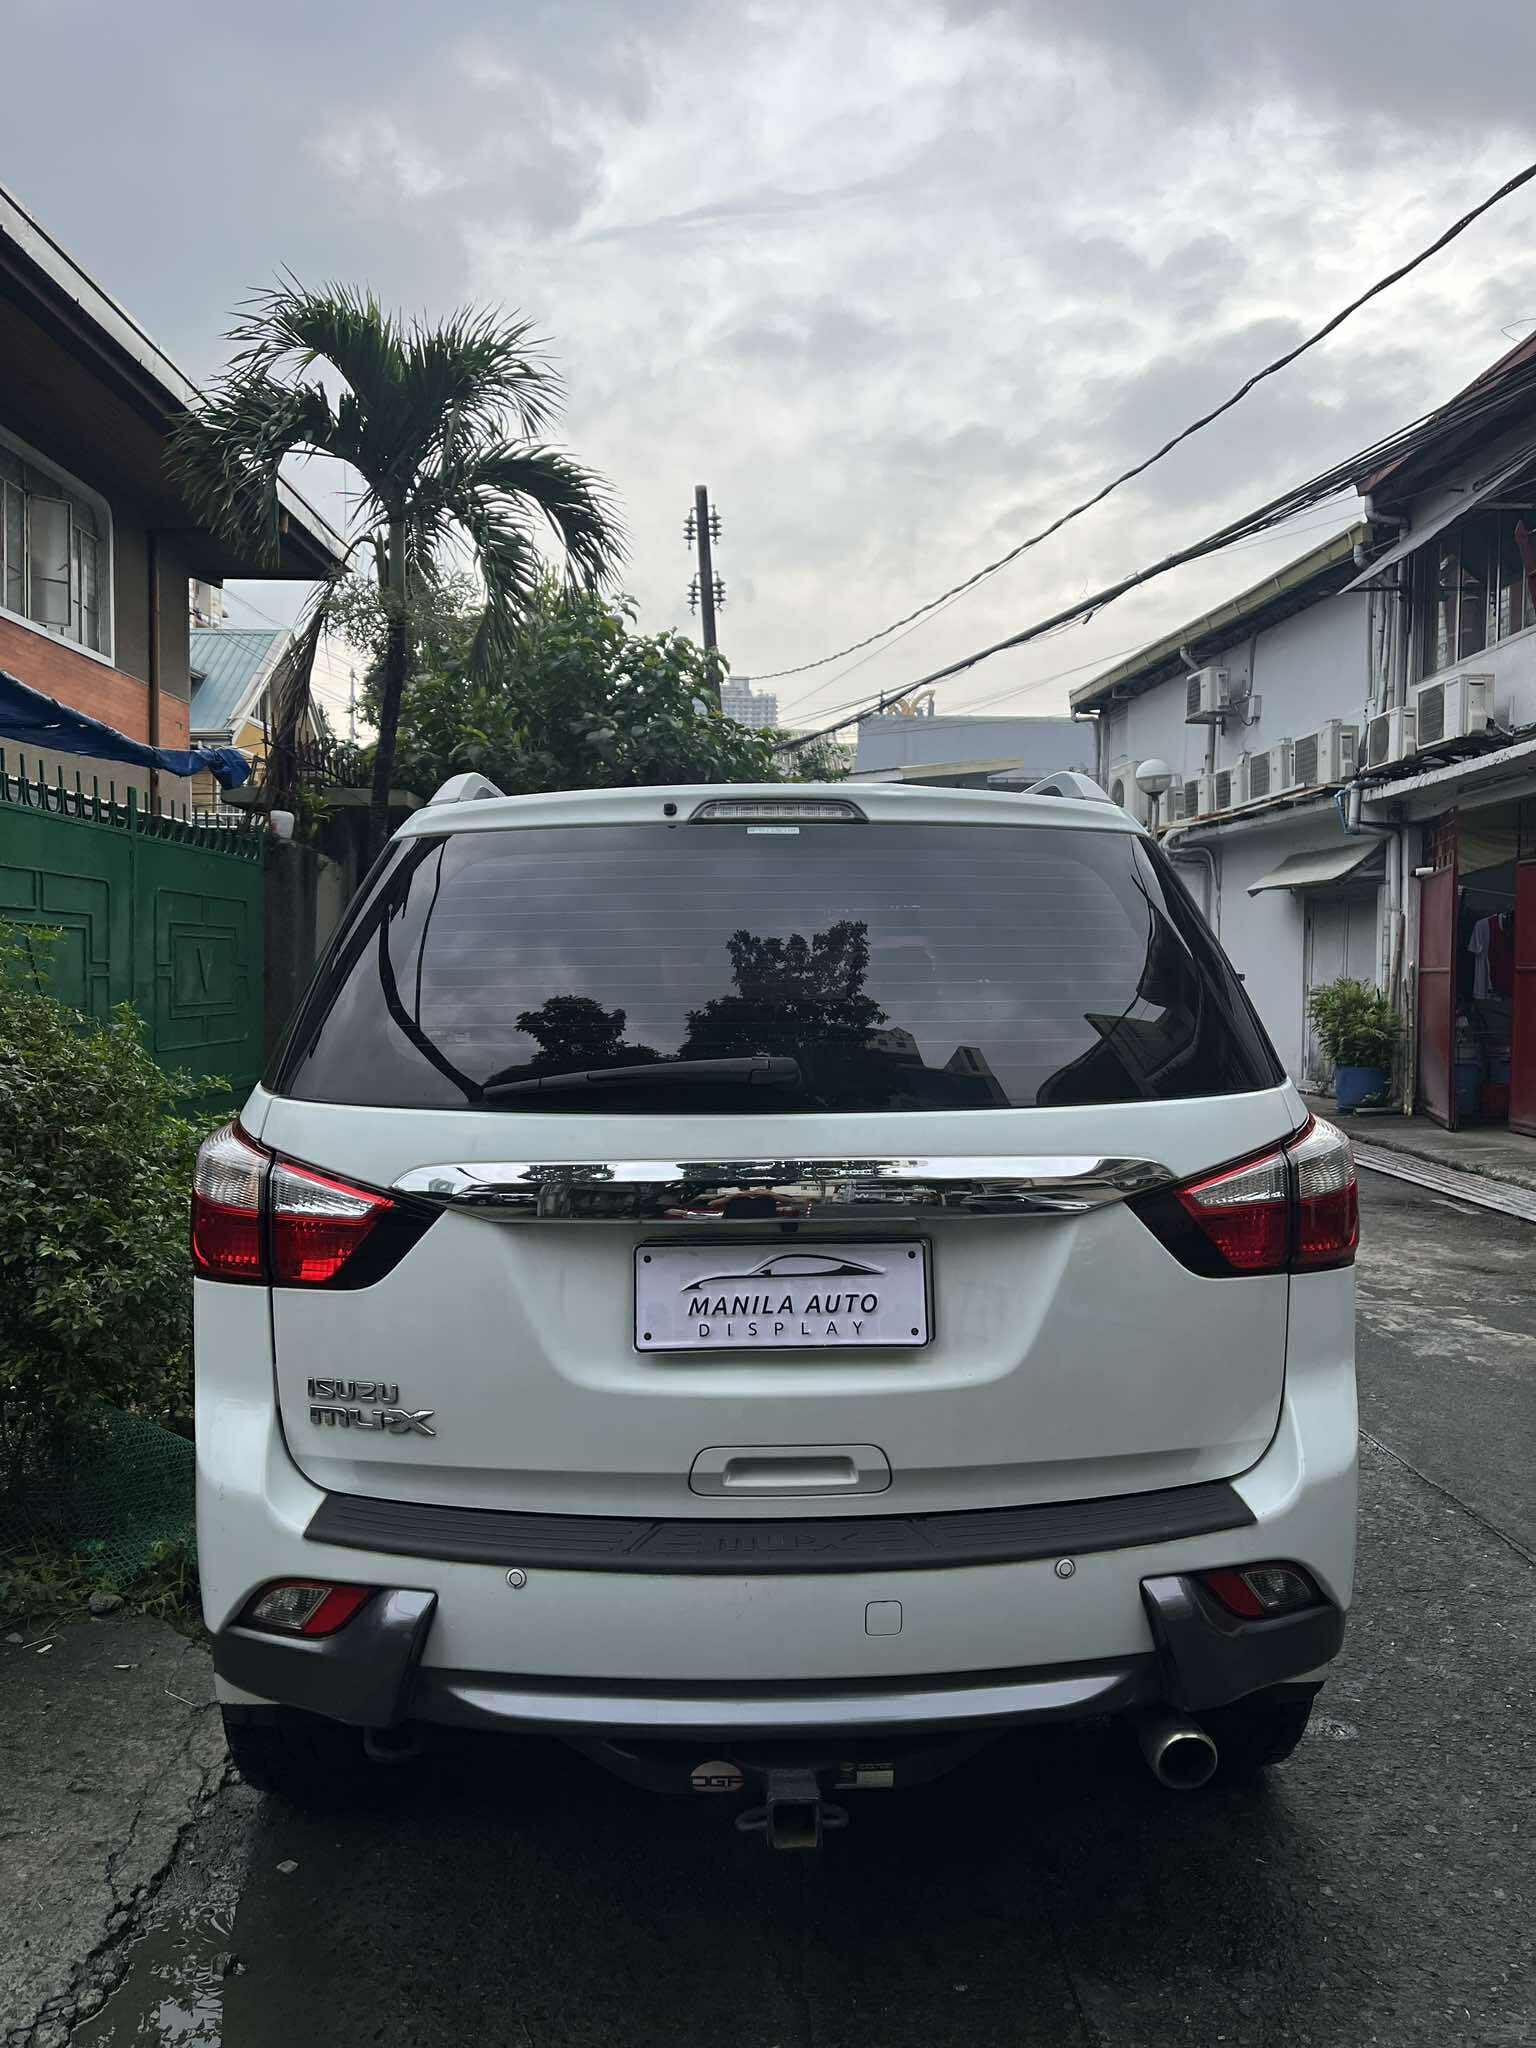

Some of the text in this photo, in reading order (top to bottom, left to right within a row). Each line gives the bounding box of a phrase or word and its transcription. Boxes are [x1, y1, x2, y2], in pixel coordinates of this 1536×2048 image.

[688, 1293, 879, 1316] MANILA AUTO
[698, 1320, 865, 1337] DISPLAY
[307, 1377, 399, 1404] ISUZU
